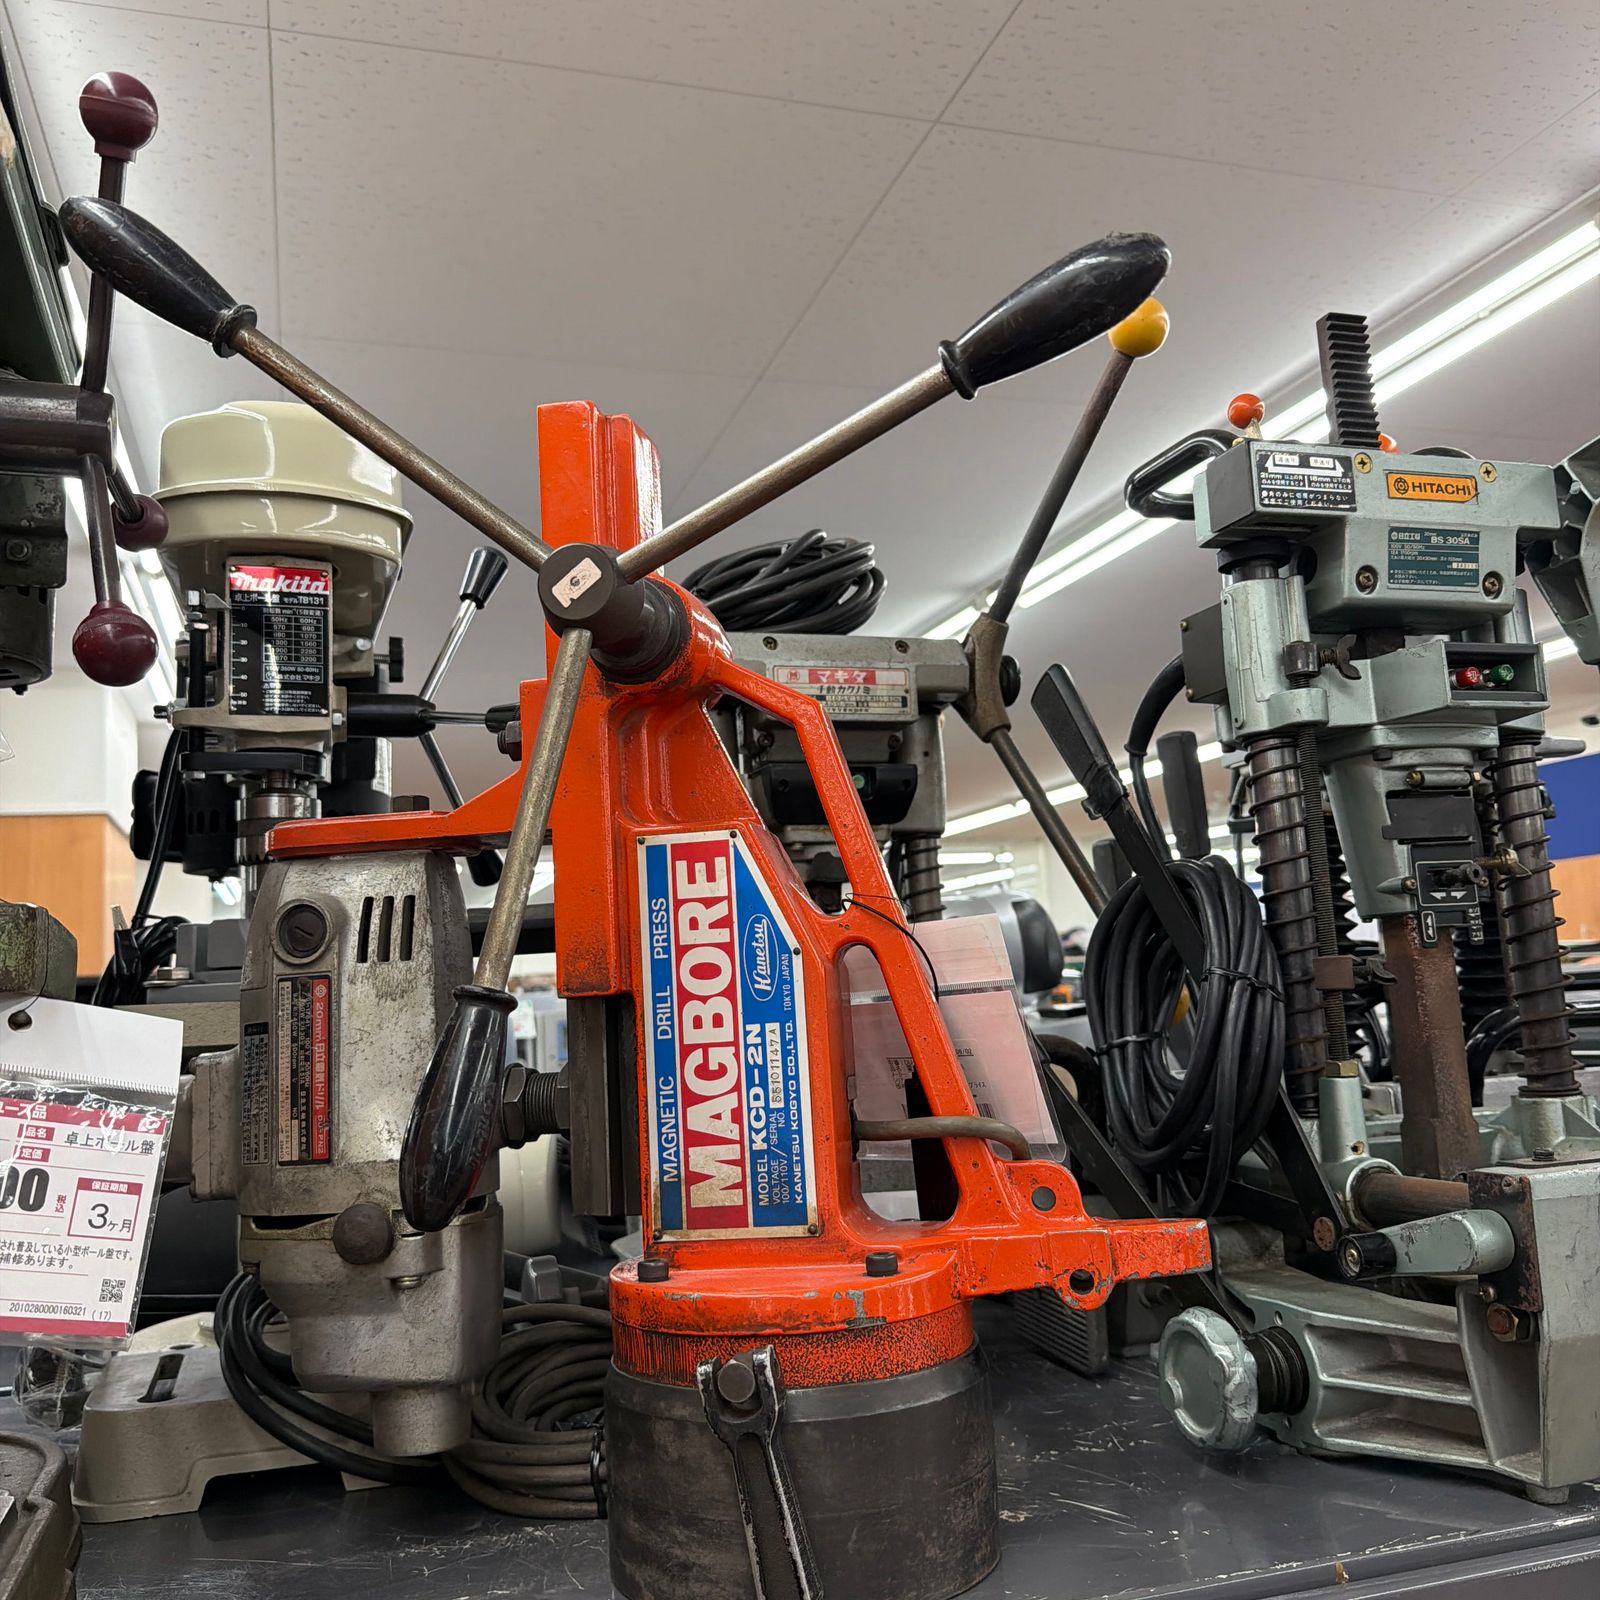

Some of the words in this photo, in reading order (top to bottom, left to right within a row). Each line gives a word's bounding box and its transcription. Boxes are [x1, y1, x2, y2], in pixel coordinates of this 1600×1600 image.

[1411, 481, 1471, 496] HITACHI
[1430, 536, 1444, 544] BS
[1445, 536, 1471, 545] 30SA
[230, 571, 329, 595] makita
[234, 592, 280, 603] 卓上ボー盤
[816, 670, 867, 684] マキタ
[652, 897, 669, 959] PRESS
[749, 918, 773, 991] Kanetsu
[780, 953, 791, 982] JAPAN
[655, 985, 673, 1040] DRILL
[782, 983, 792, 1012] TOKYO
[315, 1002, 324, 1042] 20mm
[675, 856, 744, 1209] MAGBORE
[785, 1019, 797, 1076] CO.,LTD.
[745, 1023, 768, 1150] KCD-2N
[776, 1109, 786, 1128] NO.
[789, 1079, 801, 1132] KOGYO
[26, 1126, 47, 1139] 品名
[658, 1075, 679, 1182] MAGNETIC
[768, 1111, 779, 1146] SERIAL
[22, 1149, 43, 1159] 定価
[791, 1135, 804, 1204] KANETSU
[91, 1180, 129, 1193] 保証期間
[756, 1153, 770, 1206] MODEL
[770, 1159, 781, 1206] VOLTAGE
[778, 1158, 790, 1205] 100/110V
[54, 1194, 67, 1213] 税込
